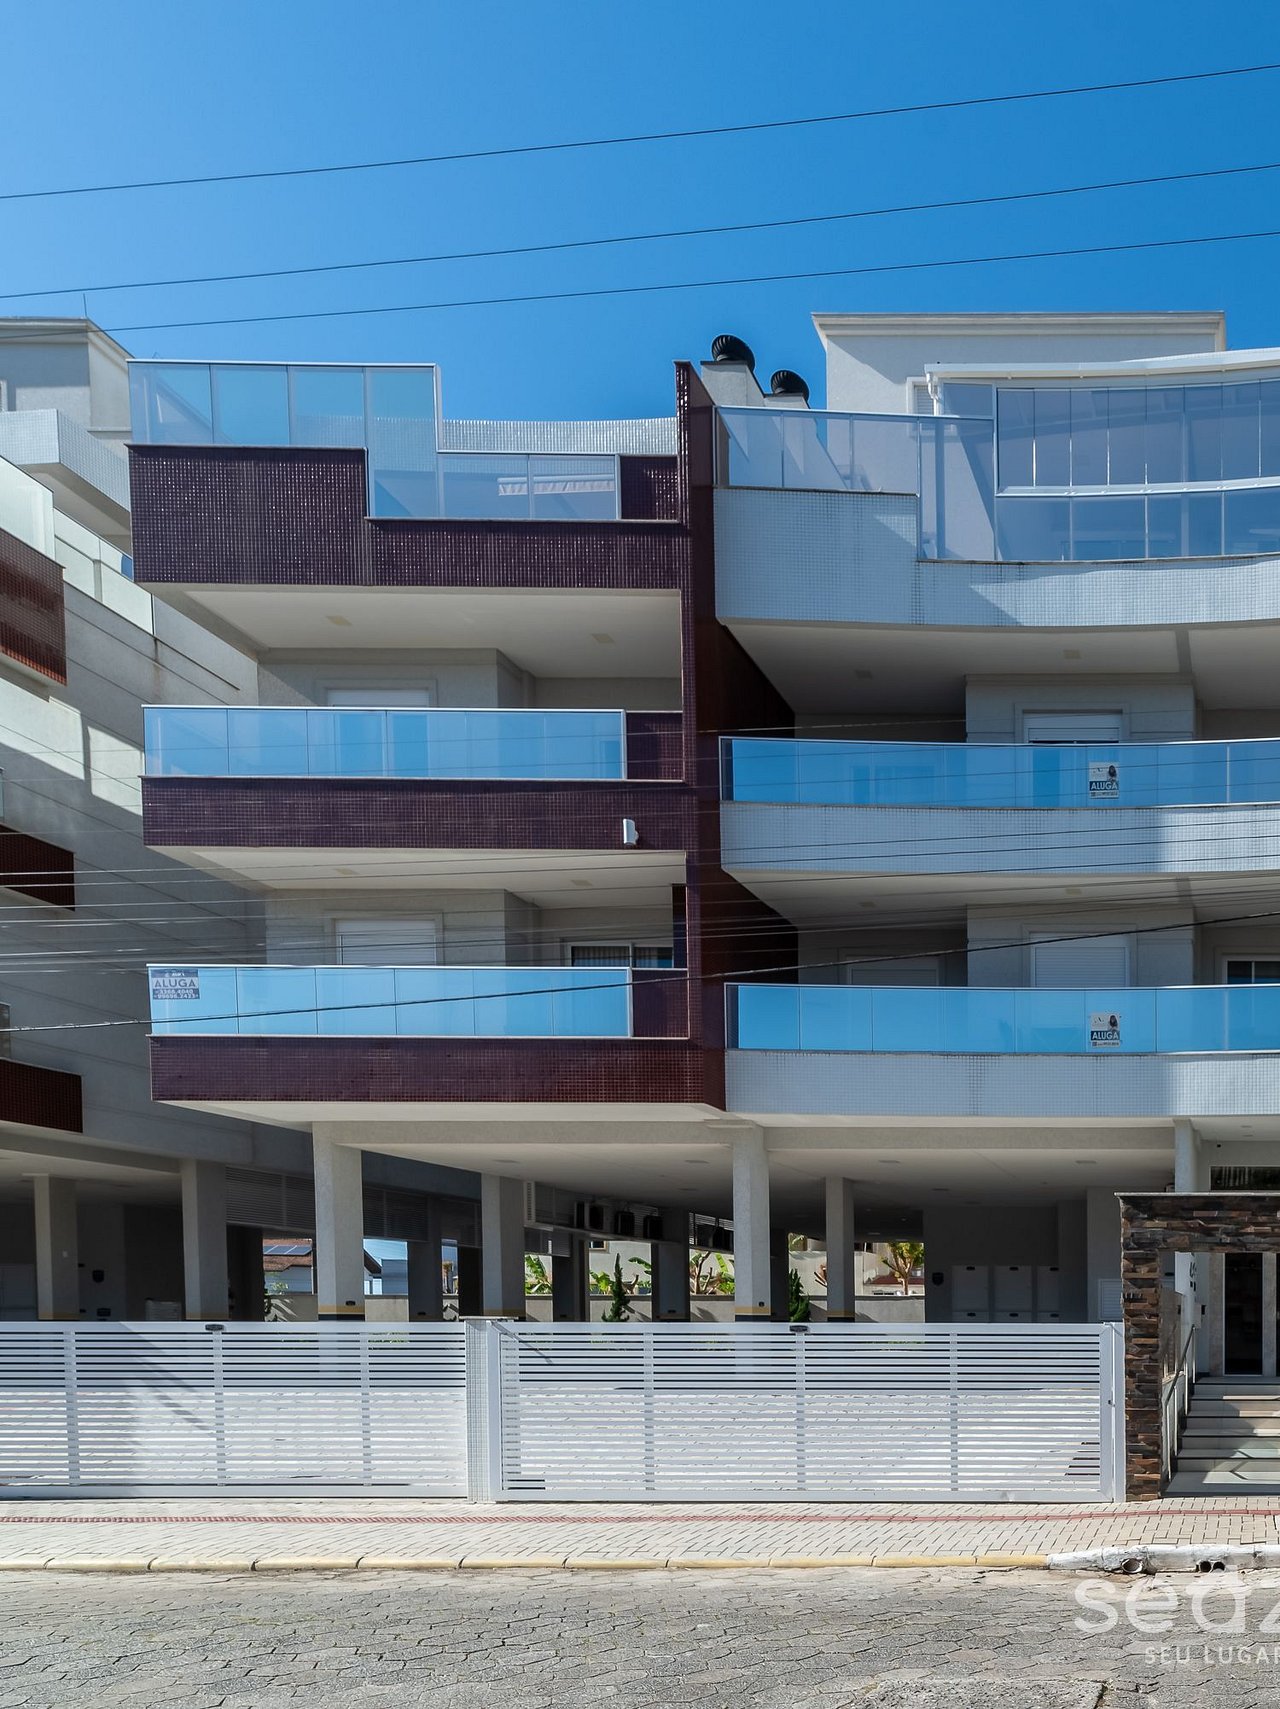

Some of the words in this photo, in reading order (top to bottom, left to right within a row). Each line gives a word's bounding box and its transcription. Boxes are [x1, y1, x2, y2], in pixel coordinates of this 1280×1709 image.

[1091, 781, 1118, 790] ALUGA
[154, 979, 196, 988] ALUGA
[1092, 1031, 1119, 1040] ALUGA
